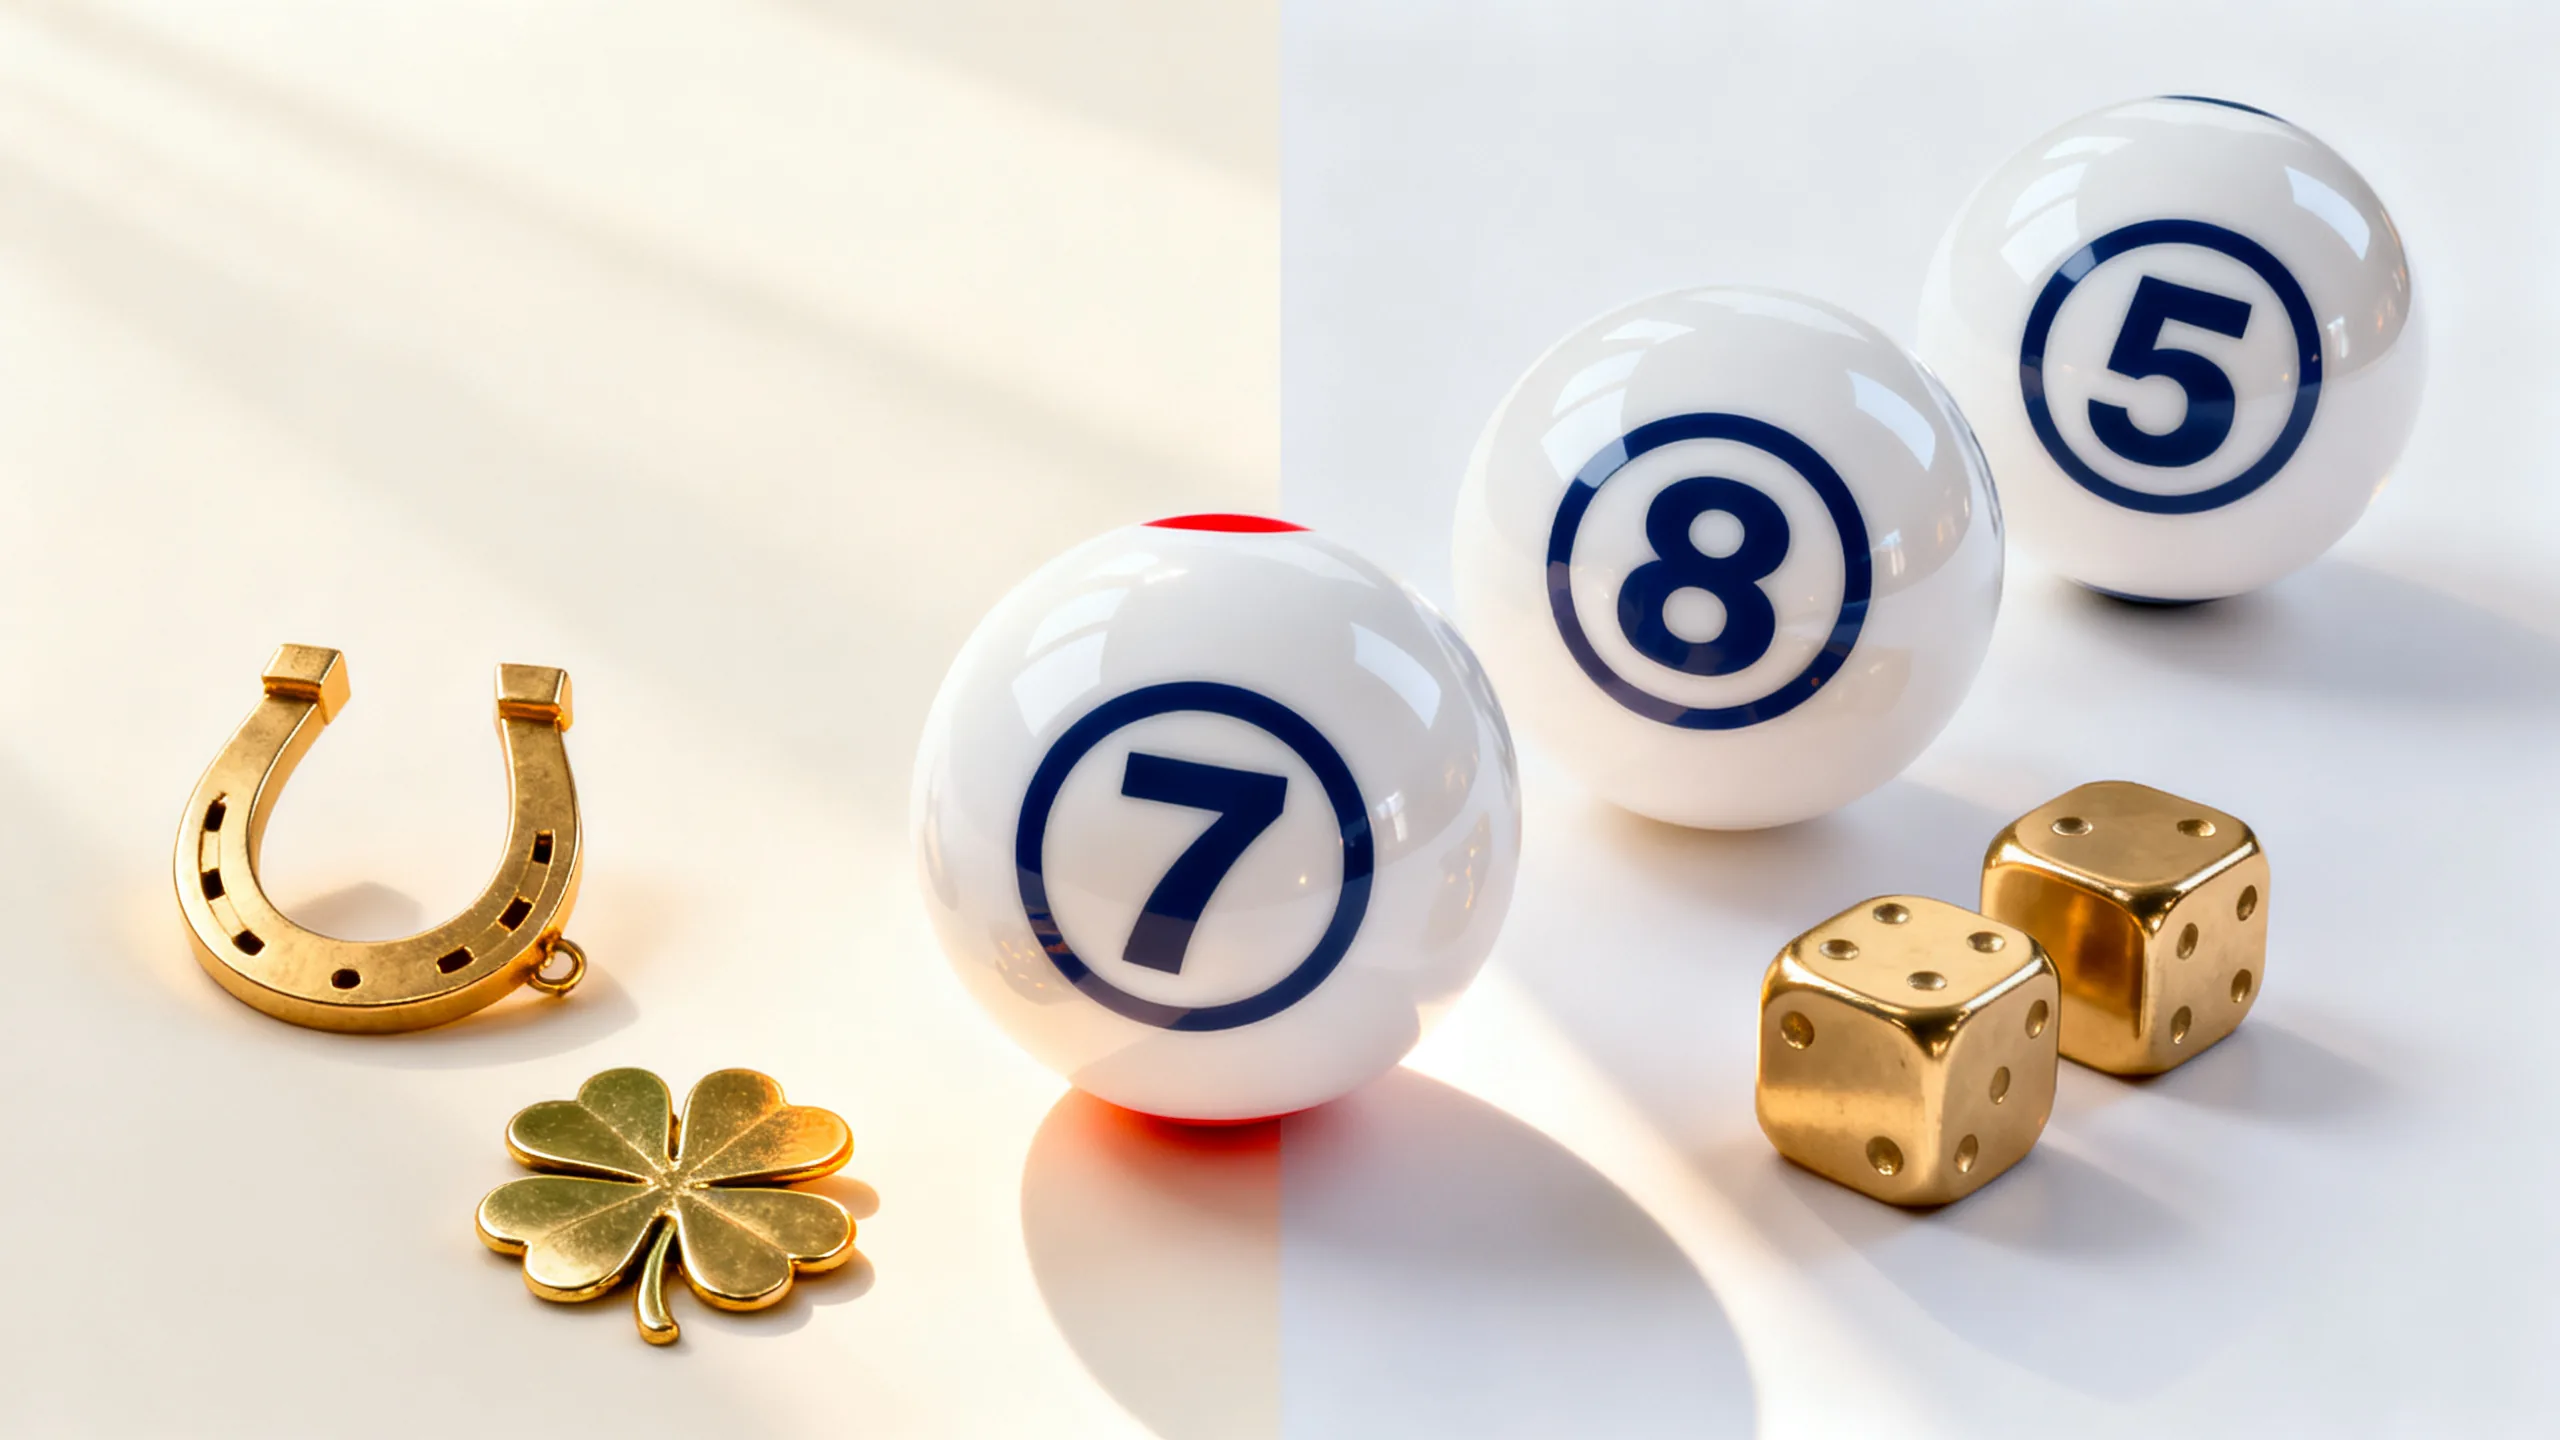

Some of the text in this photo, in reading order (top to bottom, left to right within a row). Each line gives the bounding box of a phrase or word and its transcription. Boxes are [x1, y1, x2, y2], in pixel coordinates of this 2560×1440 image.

[2088, 275, 2252, 467] 5
[1617, 476, 1790, 676] 8
[1121, 751, 1288, 975] 7
